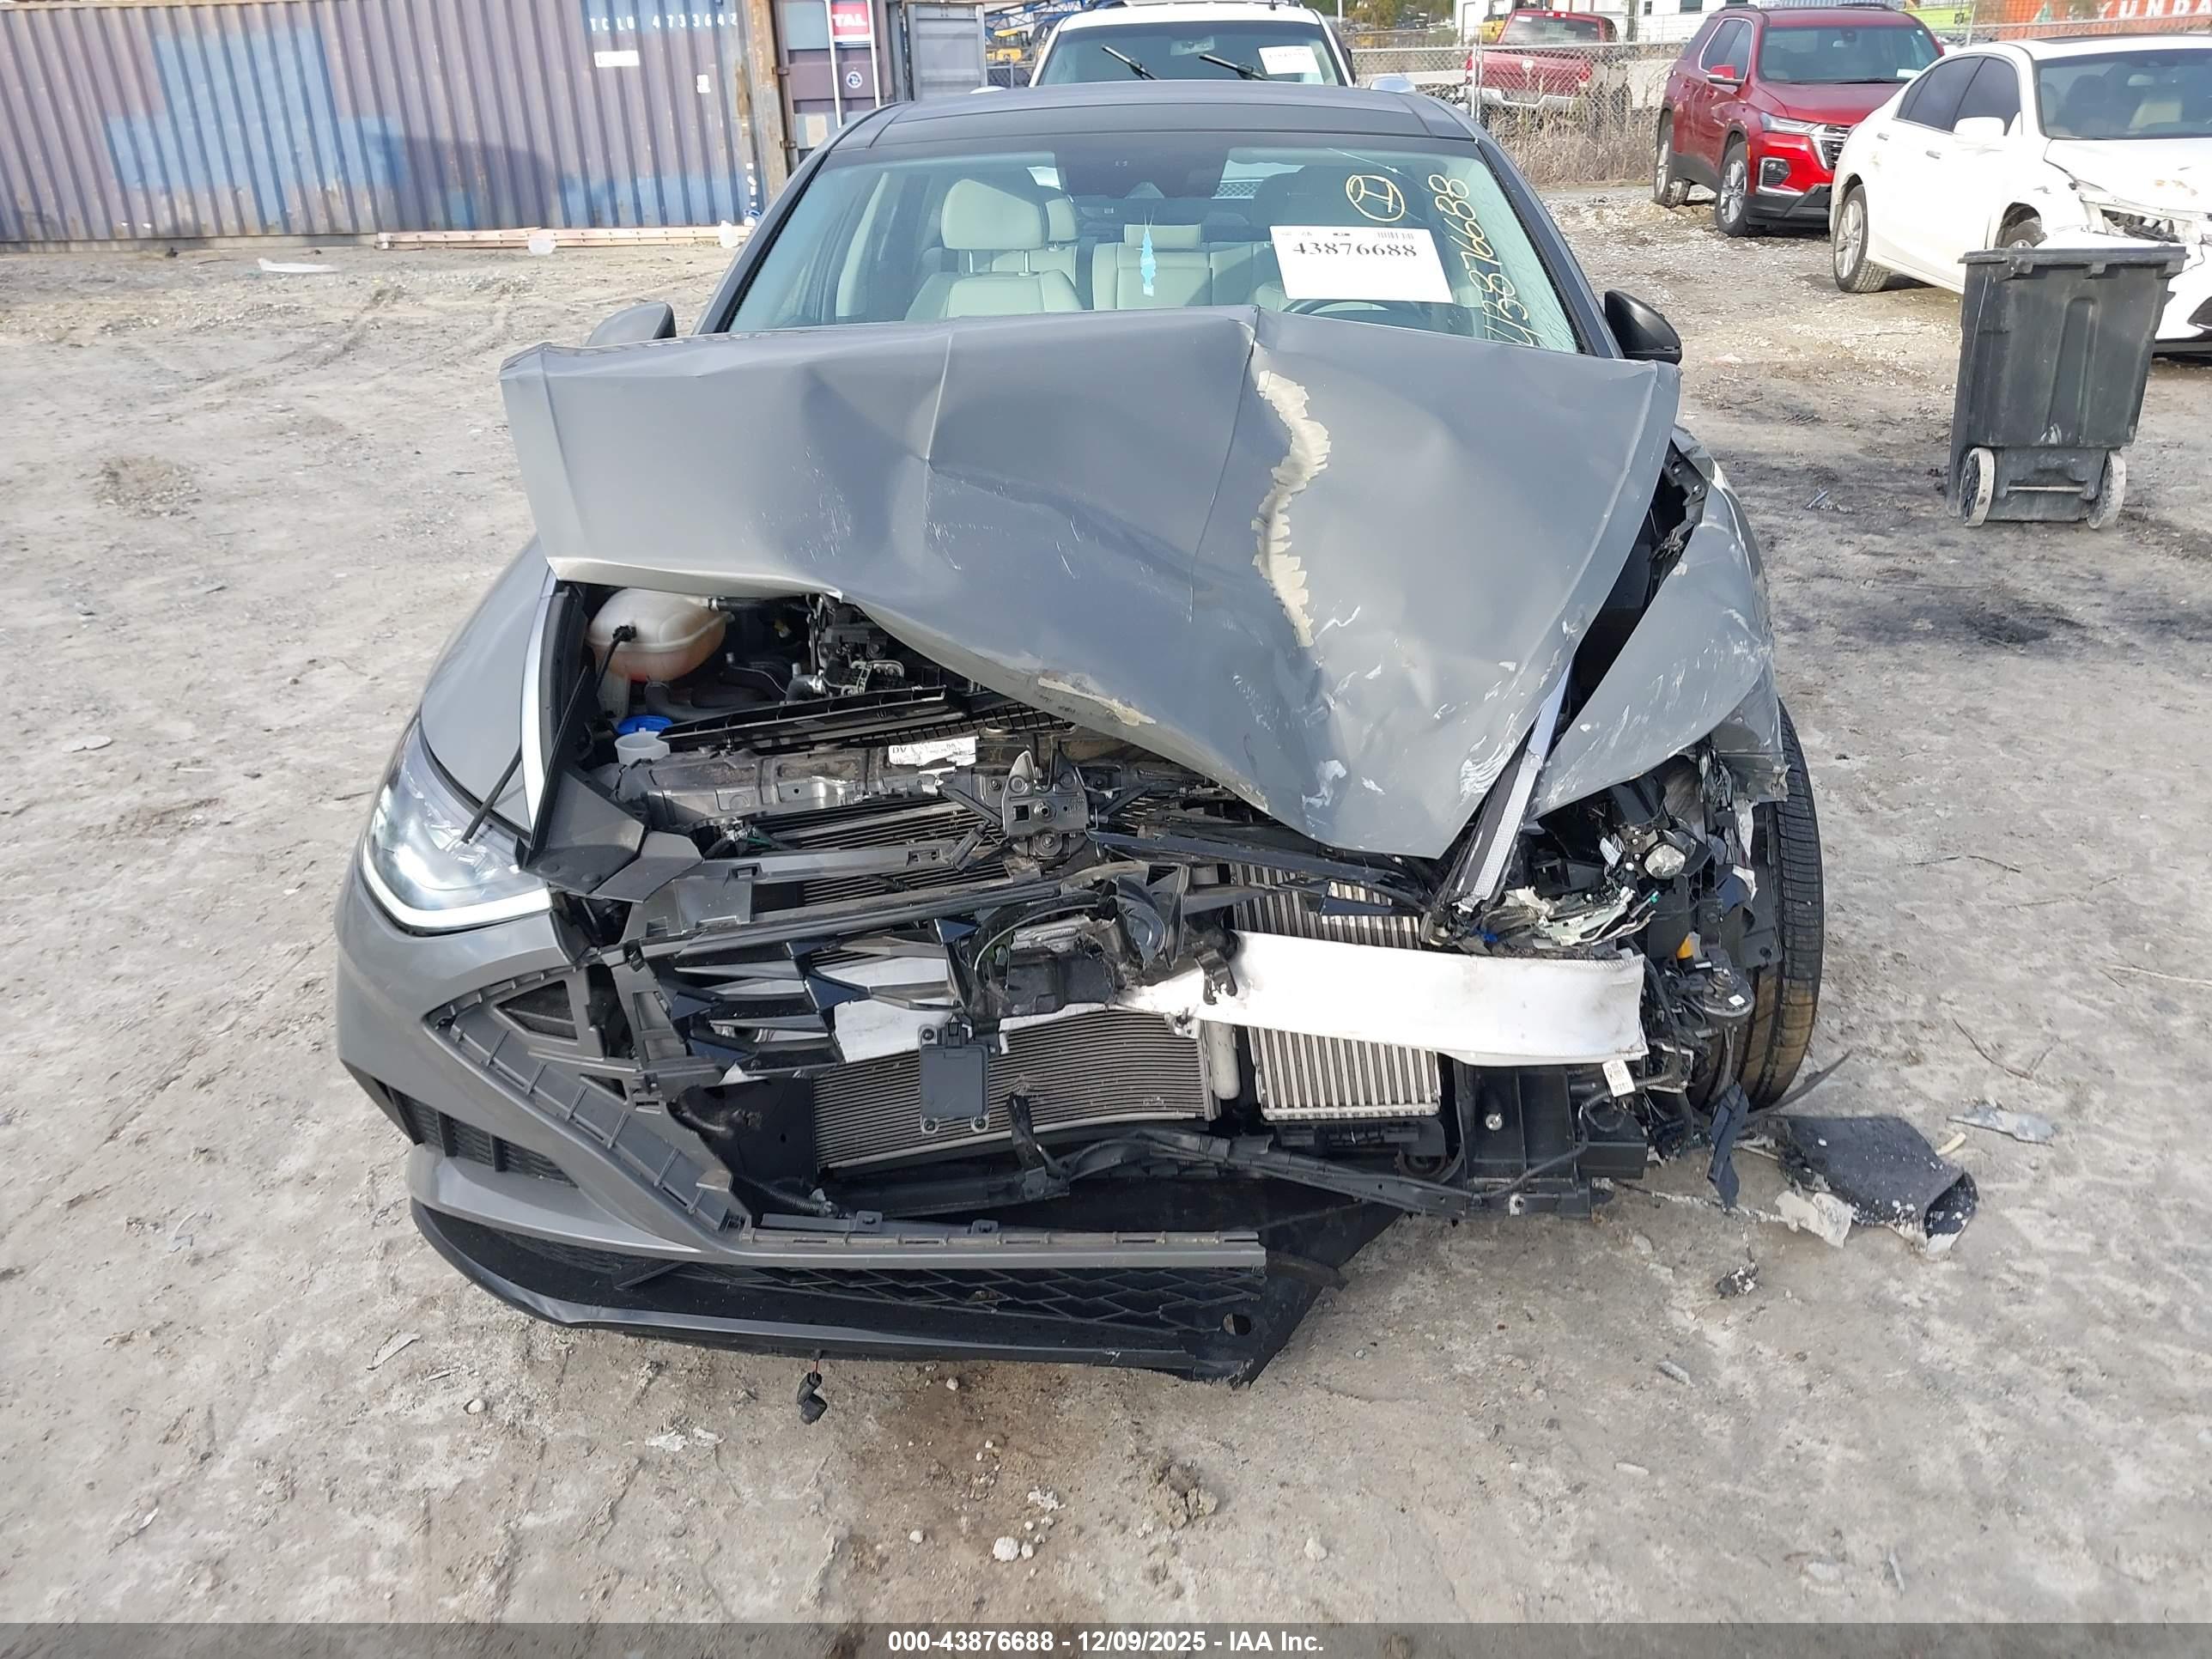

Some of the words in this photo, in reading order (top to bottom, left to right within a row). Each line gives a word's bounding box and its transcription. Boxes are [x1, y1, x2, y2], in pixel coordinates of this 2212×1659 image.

[590, 15, 635, 32] TCLU
[832, 13, 868, 27] TAL
[1292, 241, 1418, 258] 43876688
